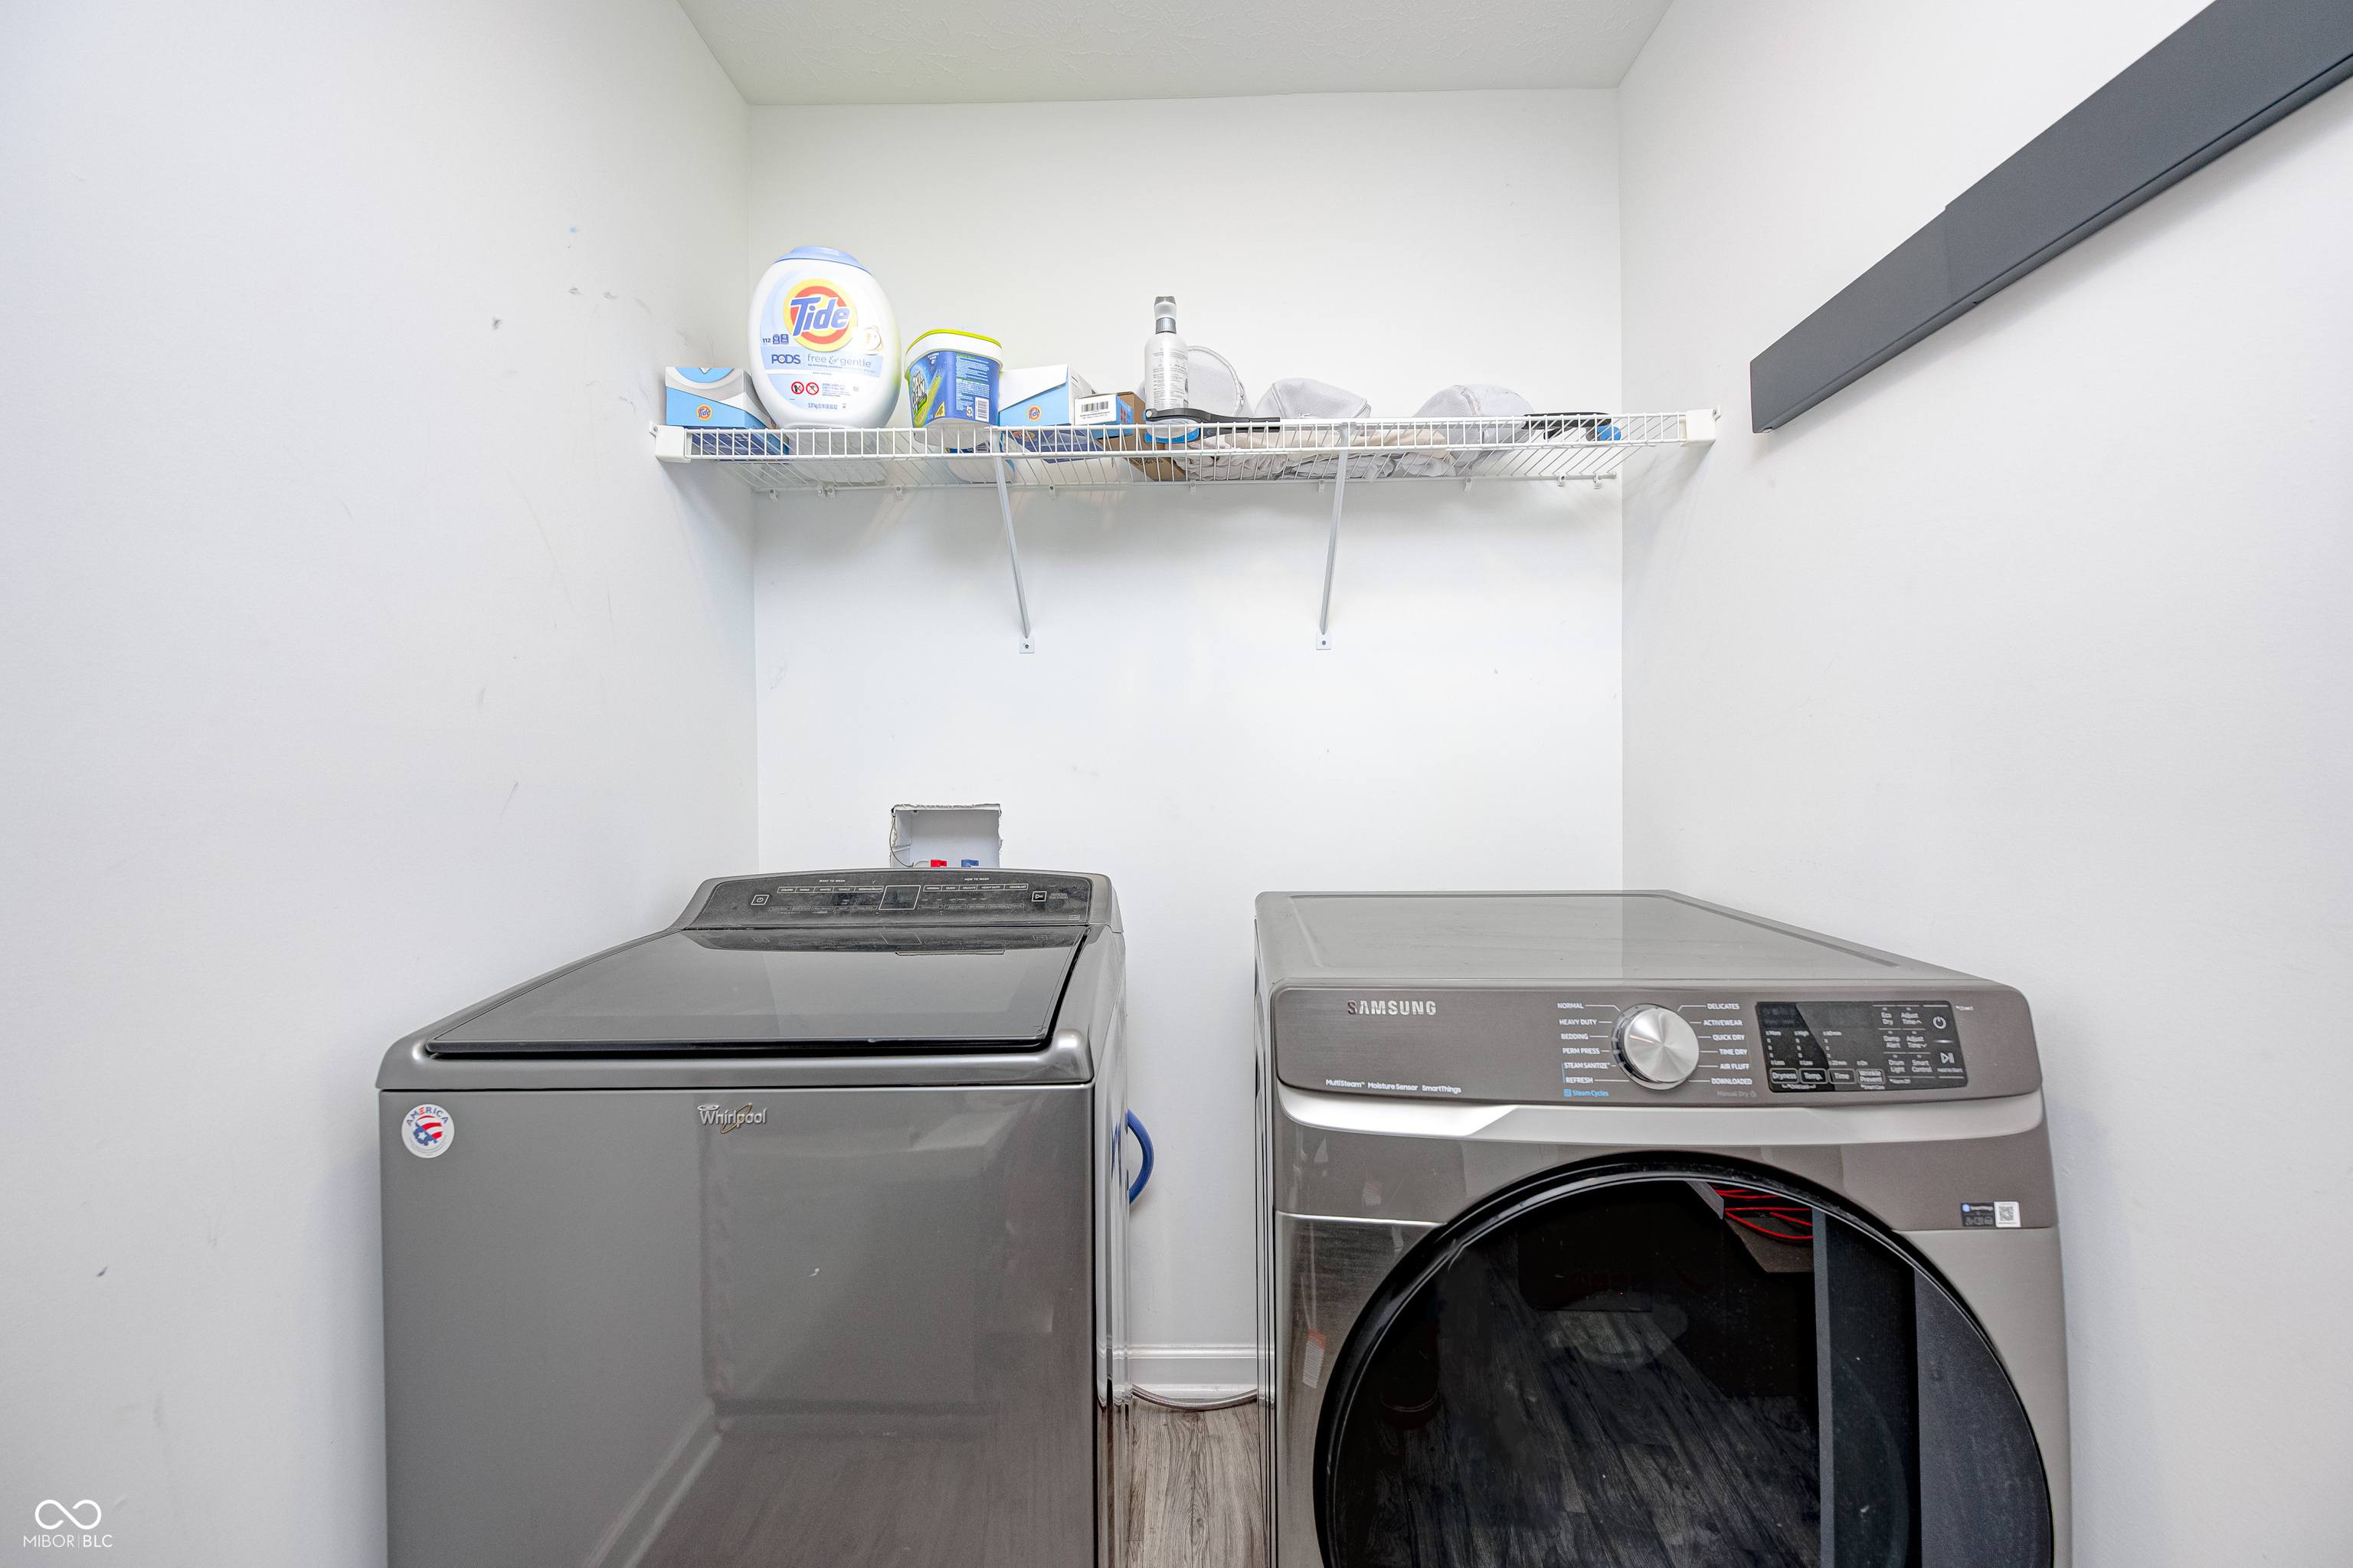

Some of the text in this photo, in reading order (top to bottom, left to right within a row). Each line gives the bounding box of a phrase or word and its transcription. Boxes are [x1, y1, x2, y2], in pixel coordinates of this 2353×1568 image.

[790, 296, 851, 337] Tide
[771, 353, 872, 368] PODS free & gentle
[698, 408, 711, 417] Tide
[1028, 409, 1040, 419] Tide
[1347, 1000, 1437, 1016] SAMSUNG
[1367, 1082, 1396, 1090] Moisture
[1422, 1085, 1461, 1095] SmartThings
[407, 1106, 449, 1127] AMERICA
[699, 1108, 767, 1128] Whirlpool
